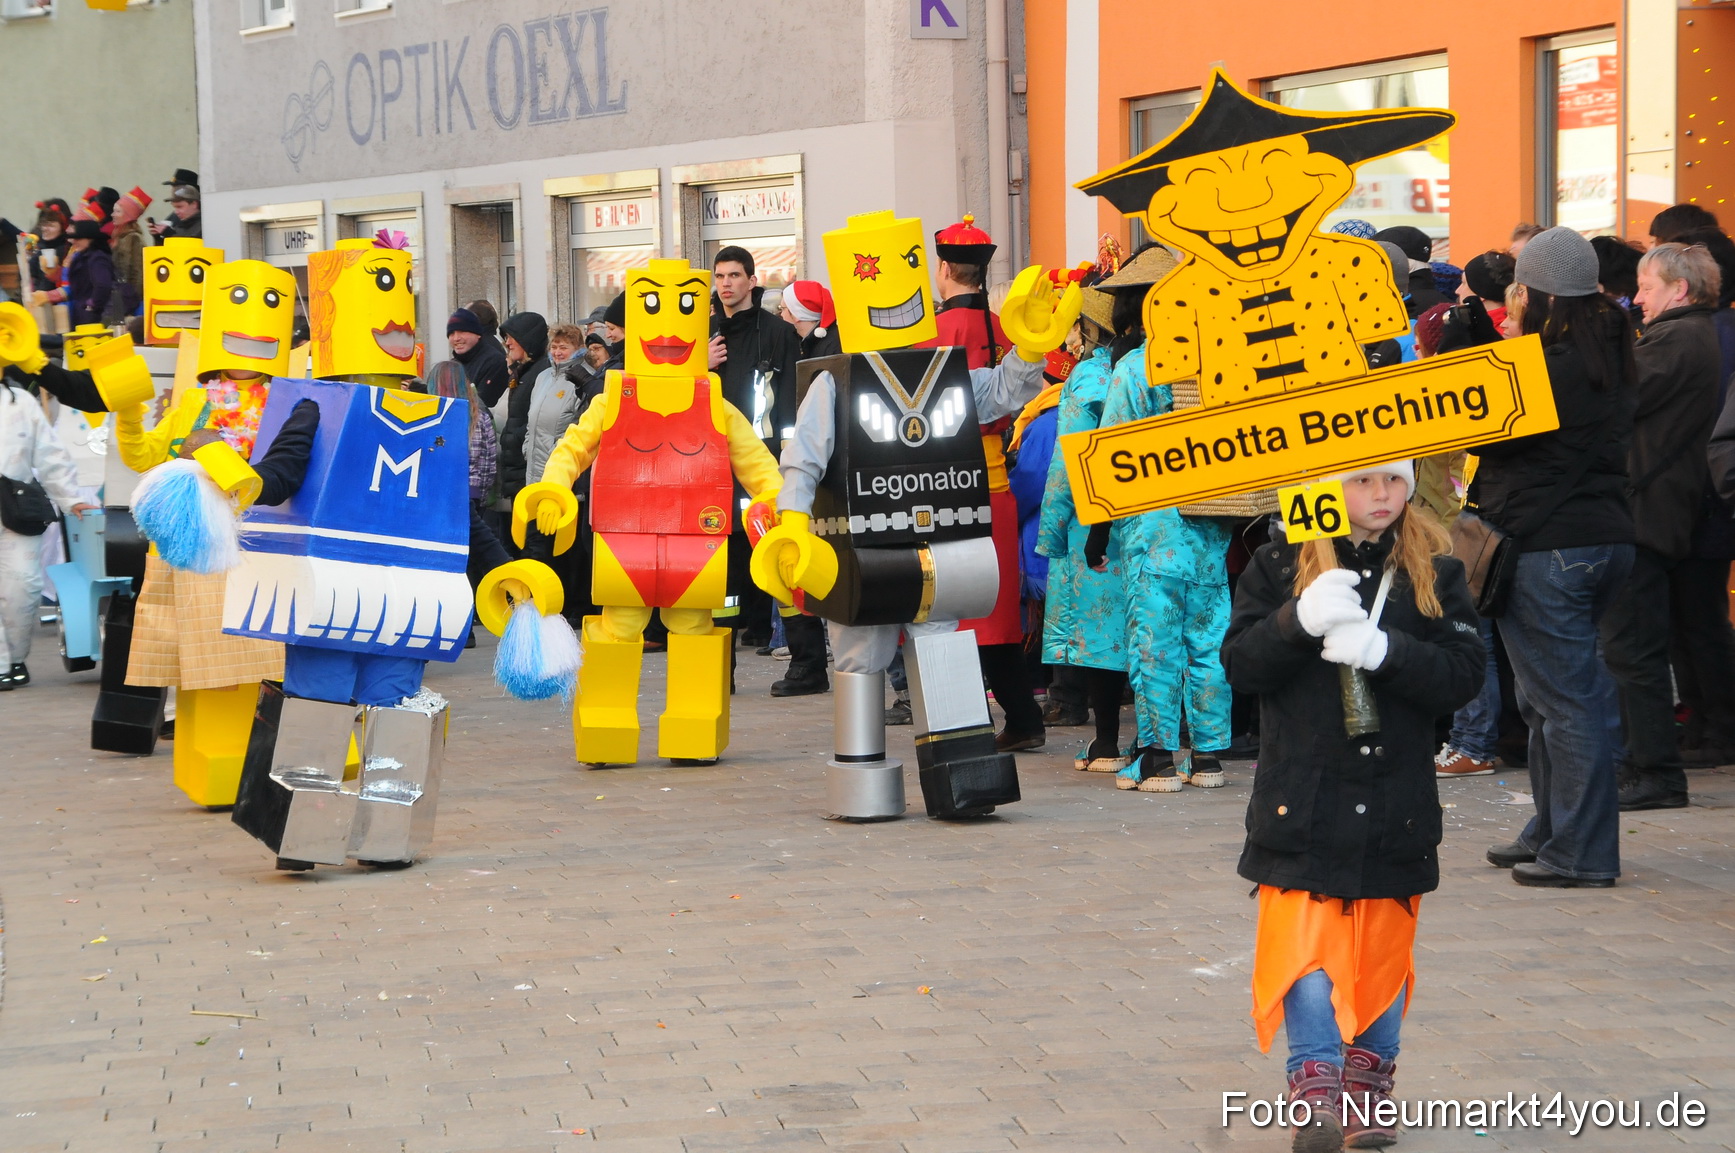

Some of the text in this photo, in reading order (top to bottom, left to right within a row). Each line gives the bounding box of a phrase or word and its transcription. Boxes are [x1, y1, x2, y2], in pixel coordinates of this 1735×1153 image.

[344, 7, 628, 145] OPTIK OEXL
[595, 202, 642, 228] BRILLEN
[907, 417, 922, 440] A
[1110, 384, 1489, 483] Snehotta Berching
[369, 443, 422, 498] M
[856, 466, 982, 500] Legonator
[1287, 492, 1342, 534] 46
